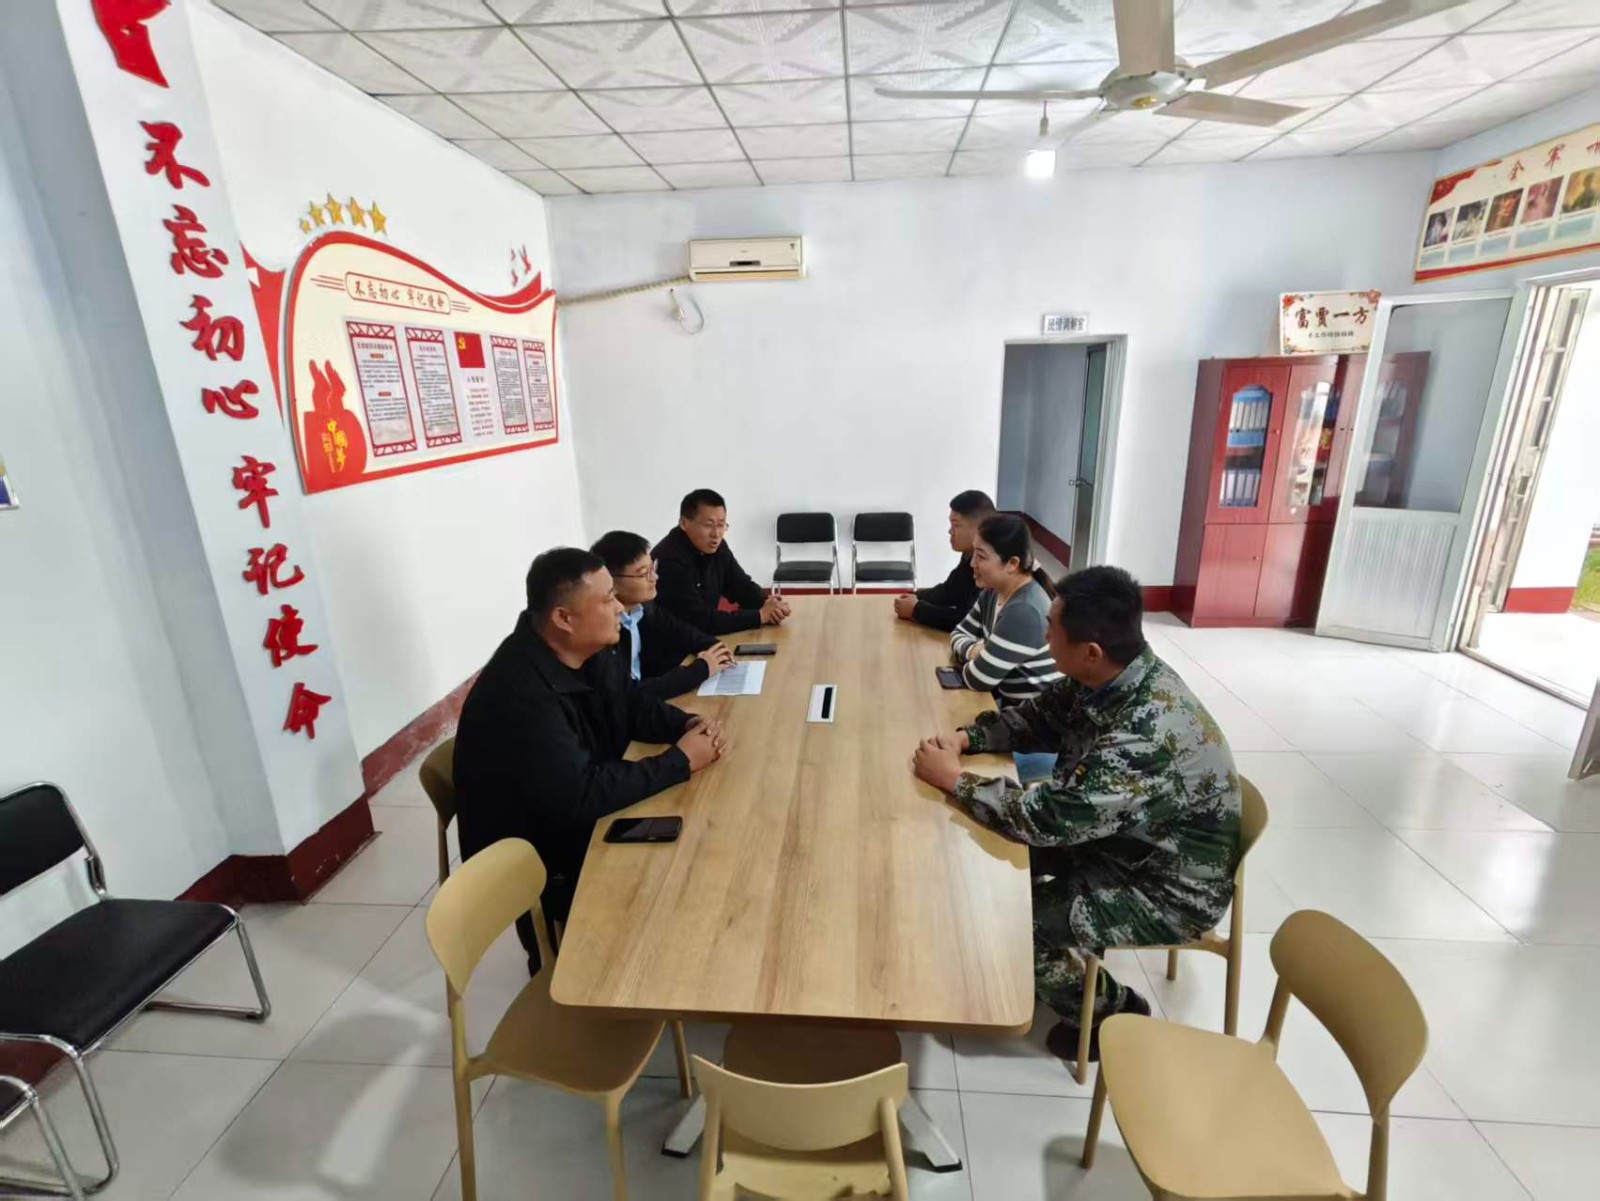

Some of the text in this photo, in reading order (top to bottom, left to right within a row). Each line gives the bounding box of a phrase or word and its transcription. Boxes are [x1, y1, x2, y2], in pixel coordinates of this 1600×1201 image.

[138, 120, 332, 740] 不忘初心牢记使命
